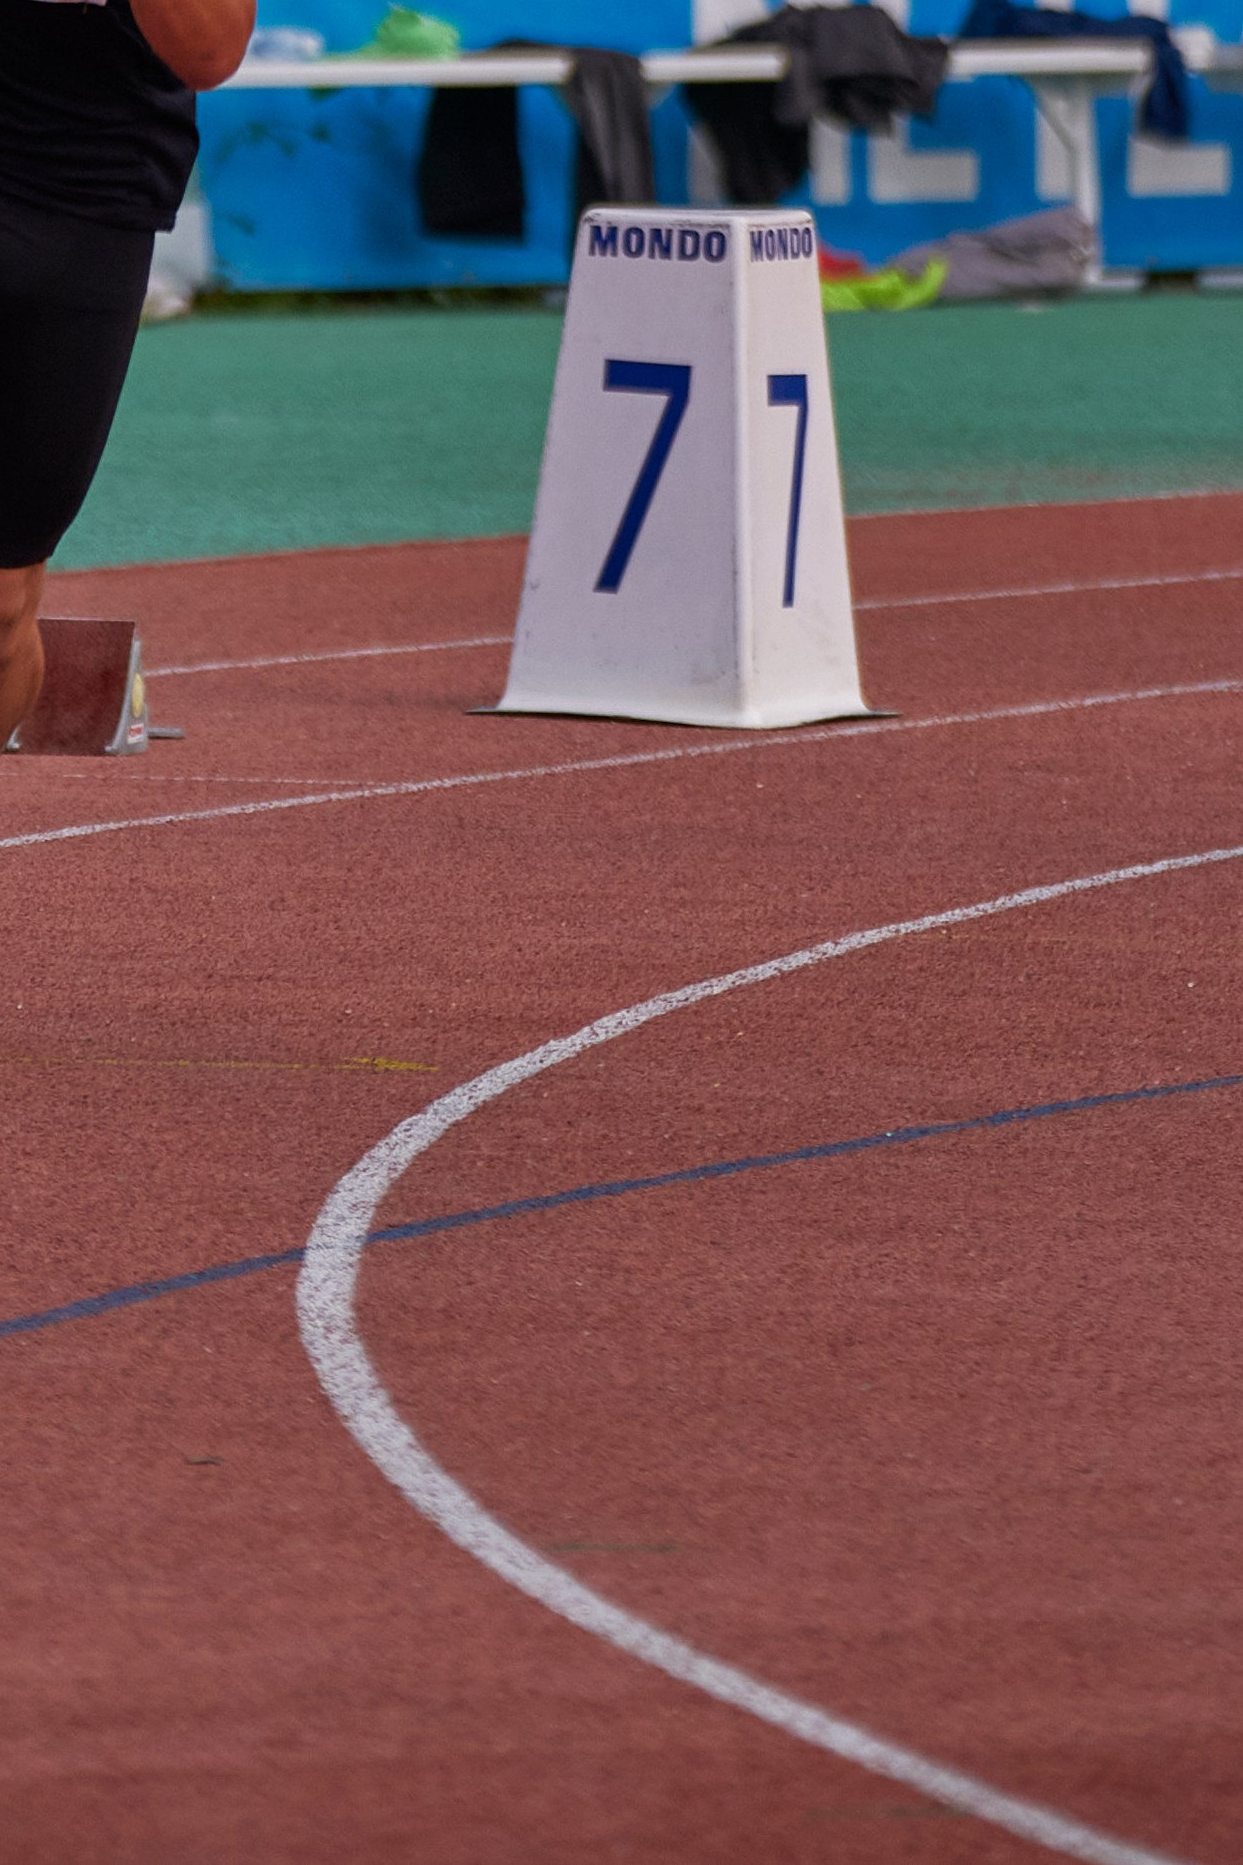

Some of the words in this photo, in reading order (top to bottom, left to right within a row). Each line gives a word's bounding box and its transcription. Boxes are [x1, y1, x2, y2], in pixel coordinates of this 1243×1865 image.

[588, 225, 727, 263] MONDO
[750, 227, 813, 262] MONDO
[593, 358, 692, 594] 7
[767, 374, 807, 608] 7
